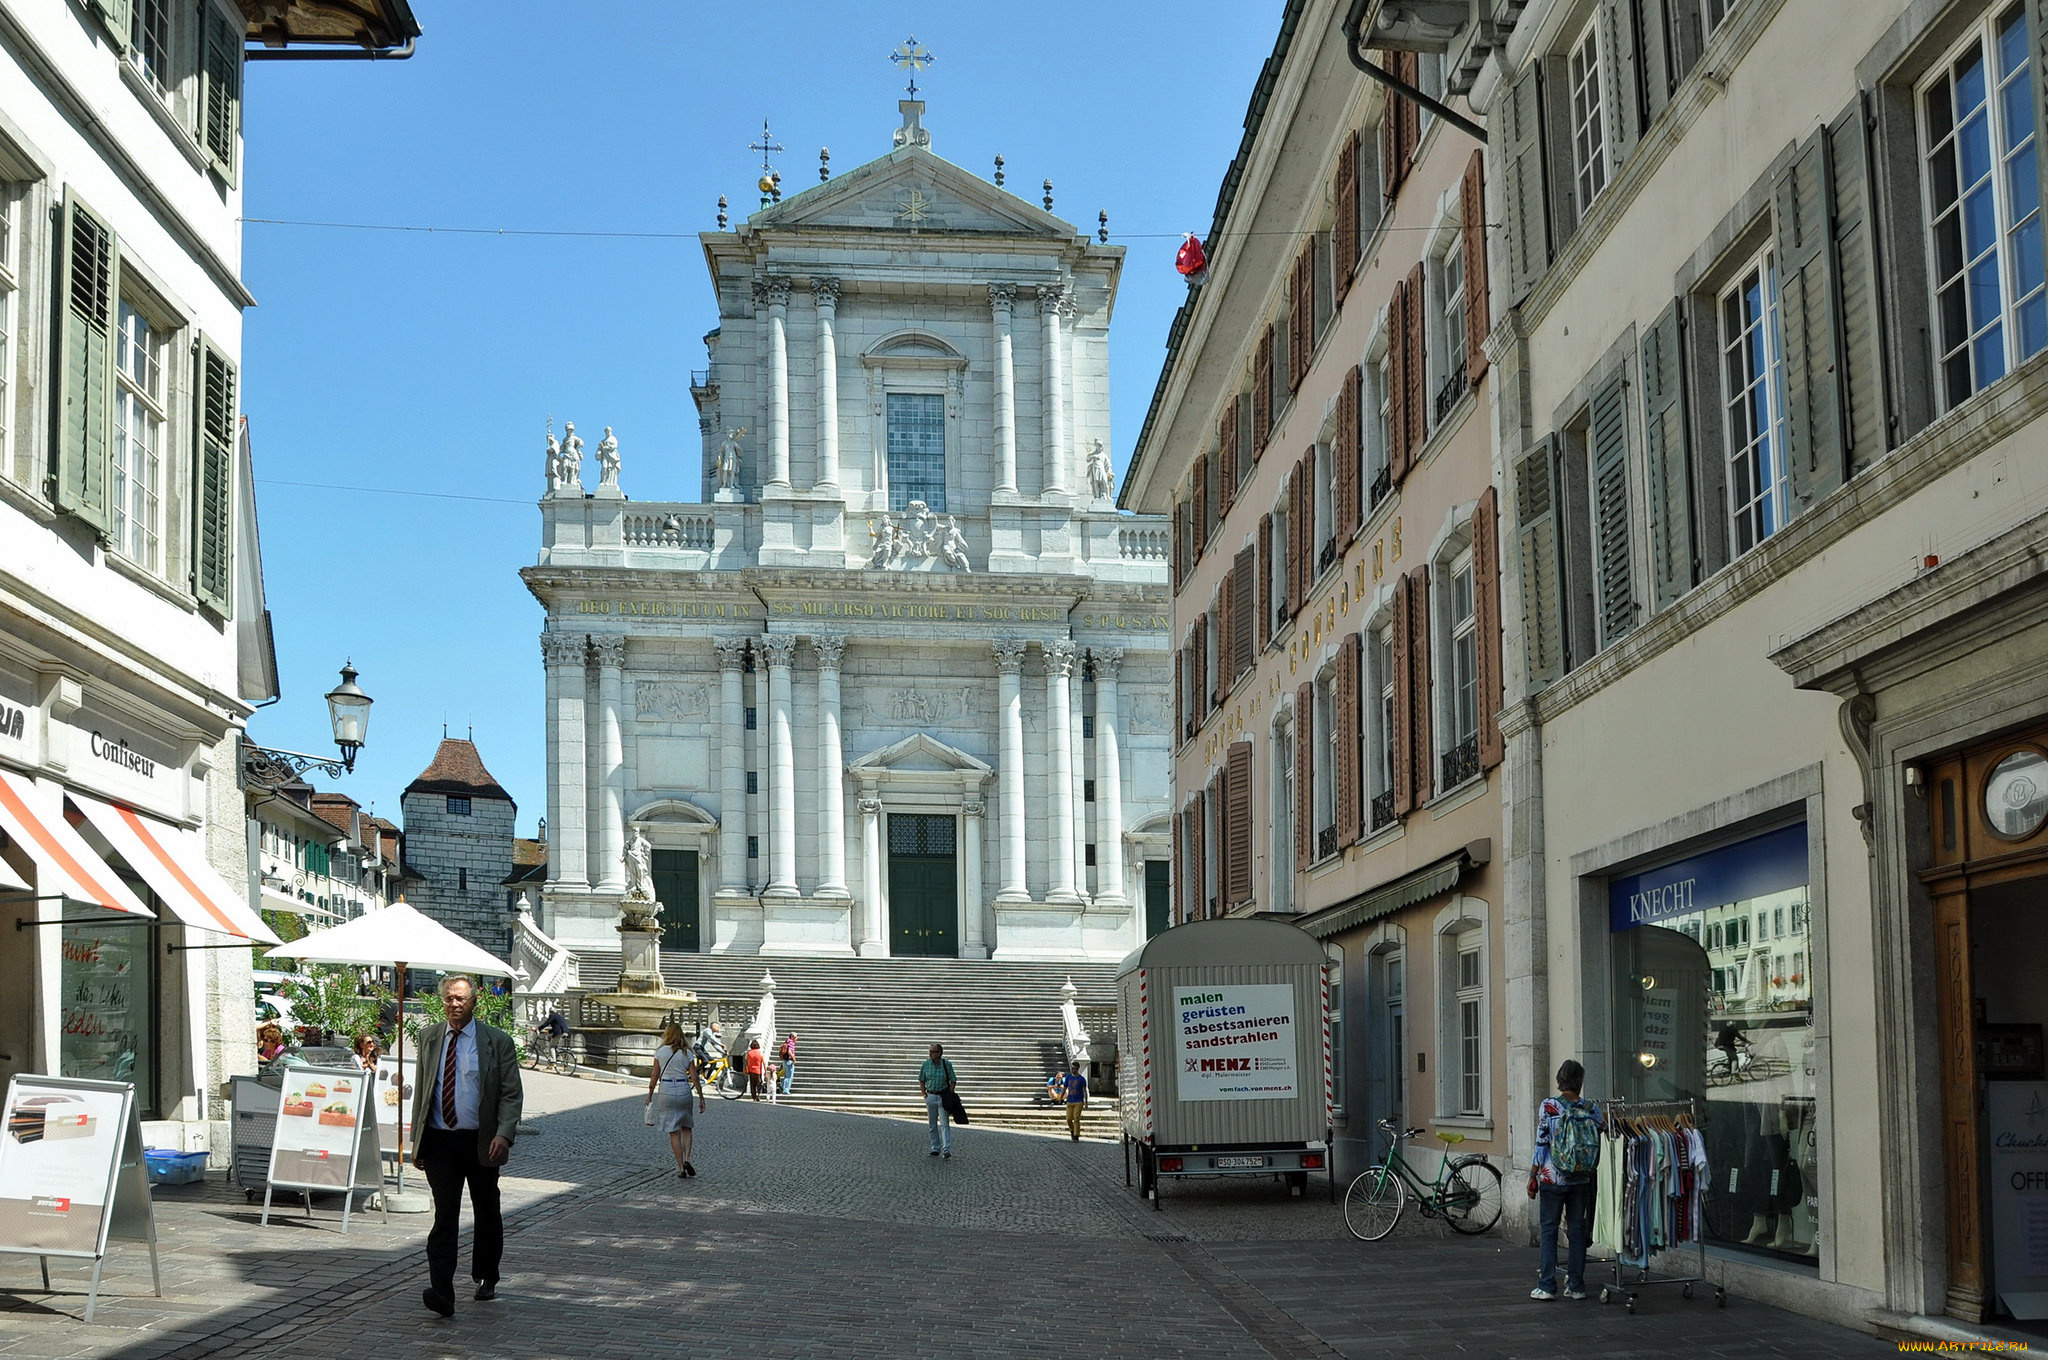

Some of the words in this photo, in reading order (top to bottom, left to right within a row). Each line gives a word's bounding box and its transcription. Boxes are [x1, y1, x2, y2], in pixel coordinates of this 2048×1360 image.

[1289, 516, 1402, 676] COURONNE
[579, 600, 611, 614] DEO
[619, 601, 726, 617] EXERCITUUM
[733, 604, 751, 617] IN
[881, 603, 948, 618] VICTORE
[956, 606, 976, 618] ET
[91, 730, 155, 778] Confiseur
[1629, 878, 1696, 922] KNECHT
[1180, 992, 1223, 1006] malen
[1182, 1005, 1246, 1023] gerüsten
[1184, 1015, 1290, 1035] asbestsanieren
[1185, 1031, 1278, 1049] sandstrahlen
[1200, 1058, 1251, 1072] MENZ
